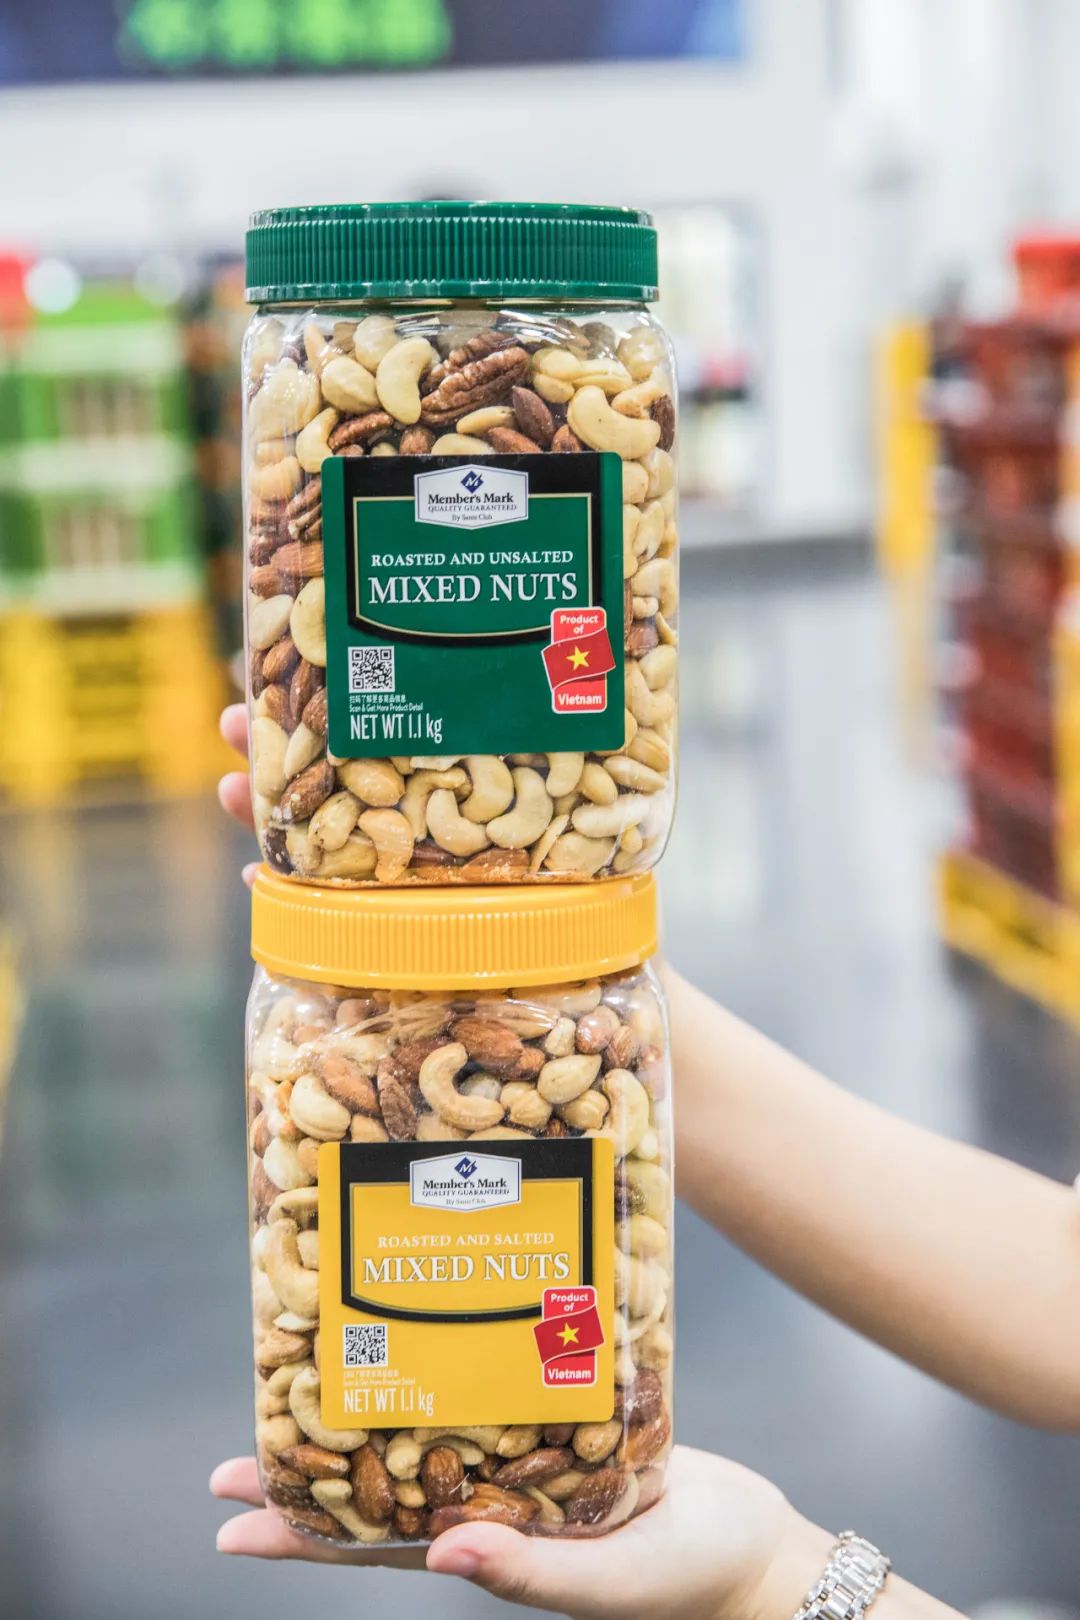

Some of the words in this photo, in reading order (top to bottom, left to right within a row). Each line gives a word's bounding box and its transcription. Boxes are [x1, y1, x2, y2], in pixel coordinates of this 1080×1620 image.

[428, 493, 480, 504] Member's
[483, 492, 514, 503] Mark
[371, 553, 446, 567] ROASTED
[450, 552, 485, 565] AND
[489, 550, 574, 565] UNSALTED
[367, 575, 481, 604] MIXED
[489, 572, 578, 601] NUTS
[560, 615, 599, 624] Product
[573, 624, 585, 634] of
[558, 694, 602, 705] Vietnam
[389, 702, 408, 712] Product
[408, 701, 424, 711] Detail
[350, 714, 378, 740] NET
[381, 713, 404, 739] WT
[408, 713, 422, 739] 1.1
[426, 712, 443, 744] kg
[423, 1179, 475, 1189] Member's
[477, 1178, 507, 1188] Mark
[377, 1235, 452, 1249] ROASTED
[456, 1234, 490, 1247] AND
[494, 1232, 555, 1246] SALTED
[362, 1255, 474, 1284] MIXED
[484, 1252, 570, 1281] NUTS
[550, 1293, 589, 1303] Product
[563, 1302, 575, 1311] of
[548, 1368, 592, 1380] Vietnam
[344, 1388, 372, 1413] NET
[375, 1388, 397, 1413] WT
[401, 1387, 414, 1412] 1.1
[418, 1386, 435, 1417] kg
